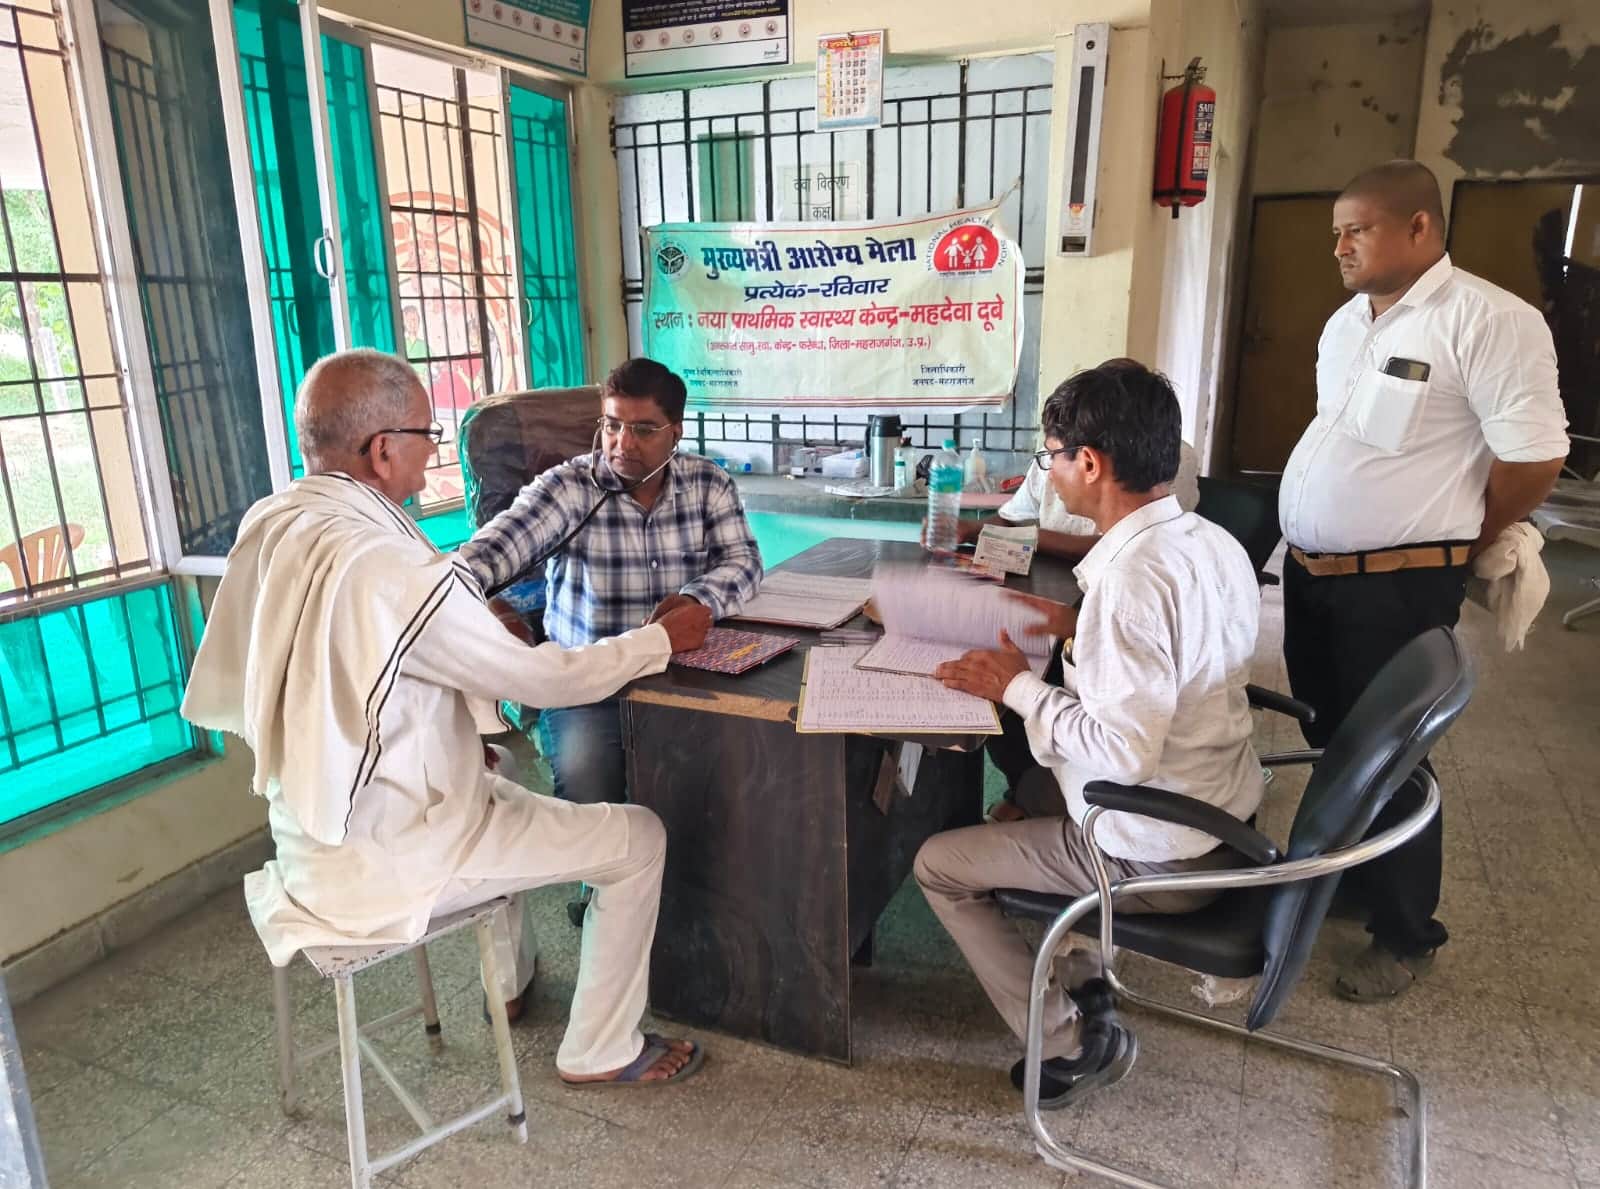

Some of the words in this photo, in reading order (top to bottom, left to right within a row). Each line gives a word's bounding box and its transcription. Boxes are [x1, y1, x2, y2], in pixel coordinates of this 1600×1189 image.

[701, 240, 782, 280] मुख्यमंत्री
[786, 239, 863, 269] आरोग्य
[866, 237, 916, 264] मेला
[697, 311, 727, 329] नया
[731, 304, 796, 330] प्राथमिक
[800, 308, 855, 329] स्वास्थ्य
[977, 293, 1004, 331] दूबे
